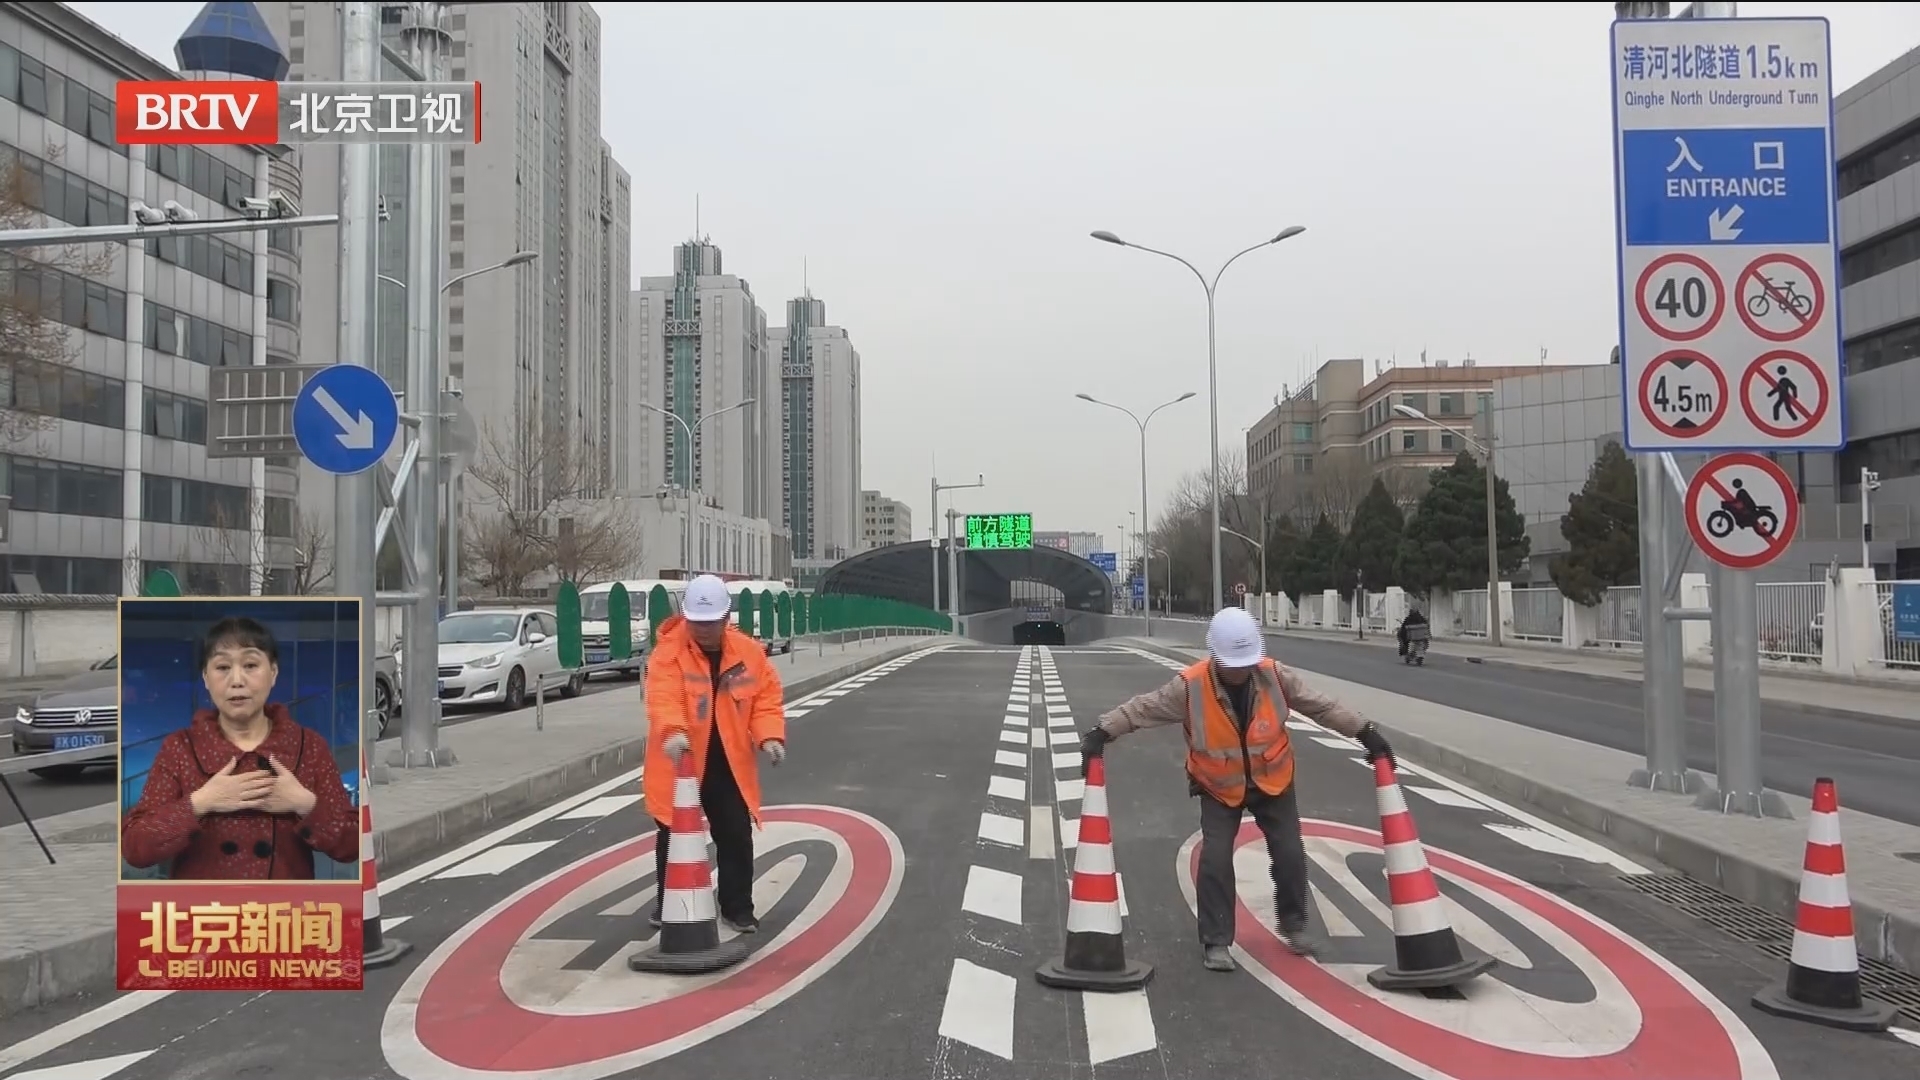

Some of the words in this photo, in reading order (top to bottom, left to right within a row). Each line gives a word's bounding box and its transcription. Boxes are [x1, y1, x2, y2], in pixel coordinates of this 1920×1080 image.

[1624, 91, 1665, 108] Qinghe
[1671, 90, 1703, 105] North
[1709, 90, 1783, 108] Underground
[1788, 89, 1819, 105] Tunn
[1666, 177, 1787, 197] ENTRANCE
[1655, 276, 1707, 319] 40
[1653, 375, 1713, 413] 4.5m
[967, 515, 1031, 532] 前方隧道
[967, 532, 1031, 548] 谨慎驾驶
